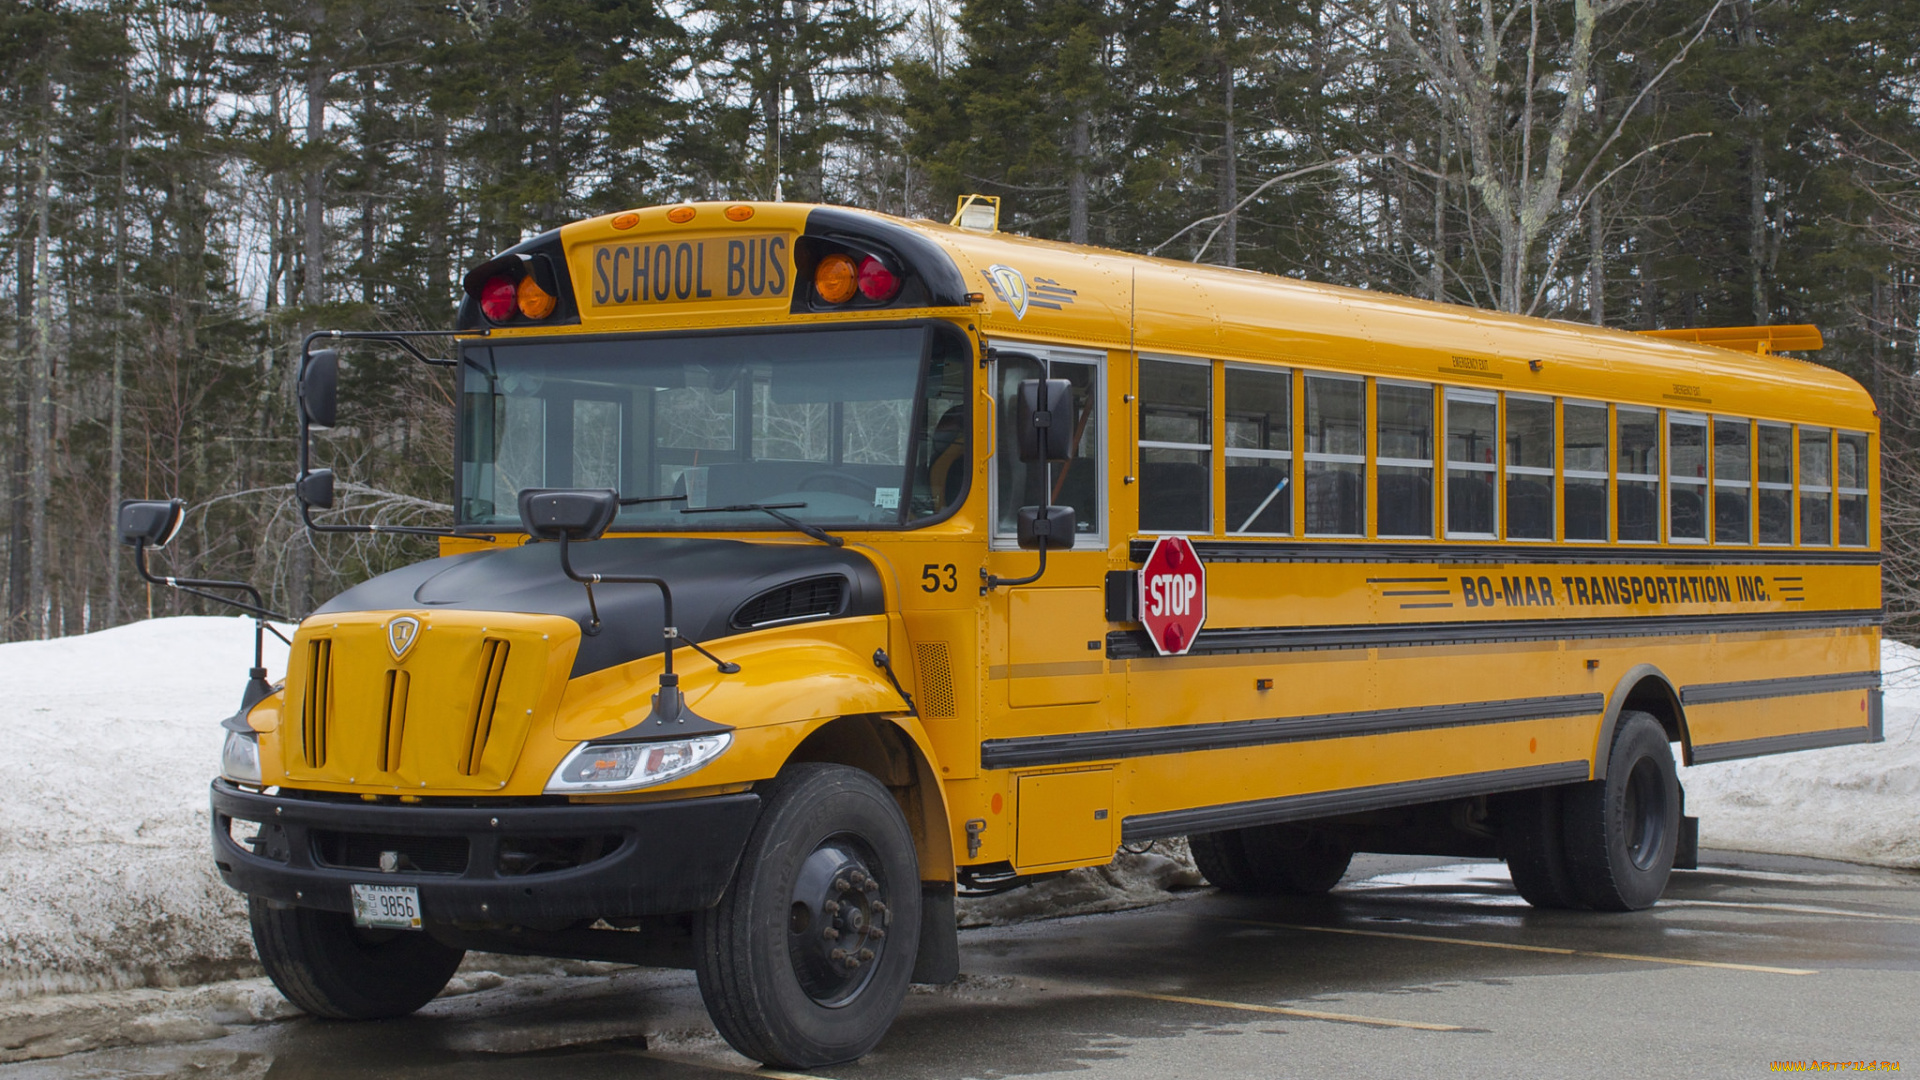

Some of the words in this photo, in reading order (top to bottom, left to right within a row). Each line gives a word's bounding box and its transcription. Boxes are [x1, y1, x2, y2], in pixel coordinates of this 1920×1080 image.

[595, 243, 712, 305] SCHOOL
[727, 236, 786, 297] BUS
[1451, 355, 1478, 370] EMERGENCY
[1478, 358, 1489, 371] EXIT
[921, 563, 958, 593] 53
[1460, 575, 1555, 607] BO-MAR
[1561, 575, 1732, 606] TRANSPORTATION
[1736, 575, 1771, 602] INC.
[1150, 573, 1197, 617] STOP
[380, 895, 414, 918] 9856
